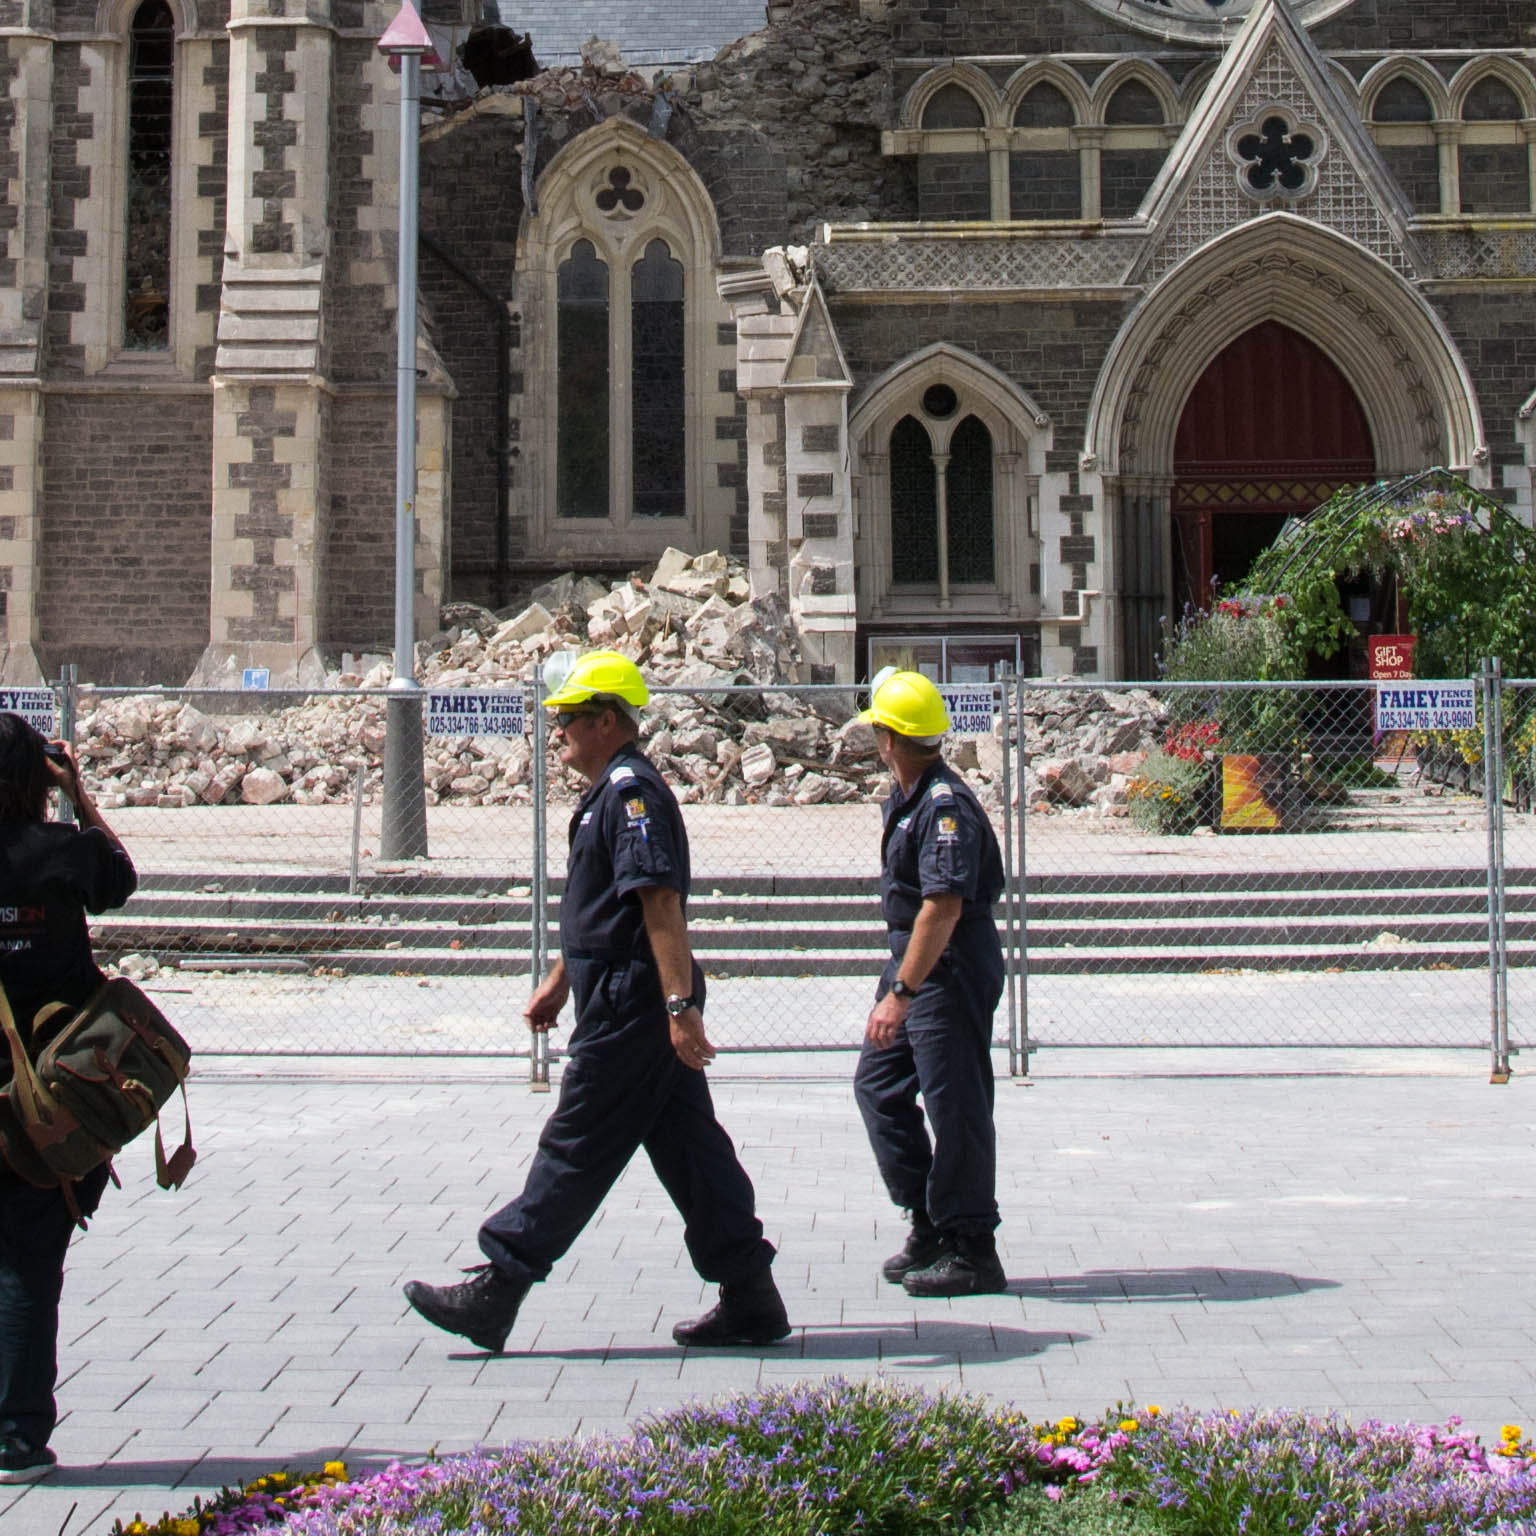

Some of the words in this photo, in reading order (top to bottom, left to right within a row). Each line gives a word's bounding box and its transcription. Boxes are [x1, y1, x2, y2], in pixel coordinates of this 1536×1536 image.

[1374, 646, 1398, 656] GIFT
[1375, 655, 1404, 666] SHOP
[960, 694, 991, 702] FENCE
[1380, 690, 1440, 708] FAHEY
[1441, 690, 1473, 698] FENCE
[430, 696, 489, 713] FAHEY
[491, 696, 523, 704] FENCE
[960, 703, 991, 711] HIRE
[1441, 700, 1473, 708] HIRE
